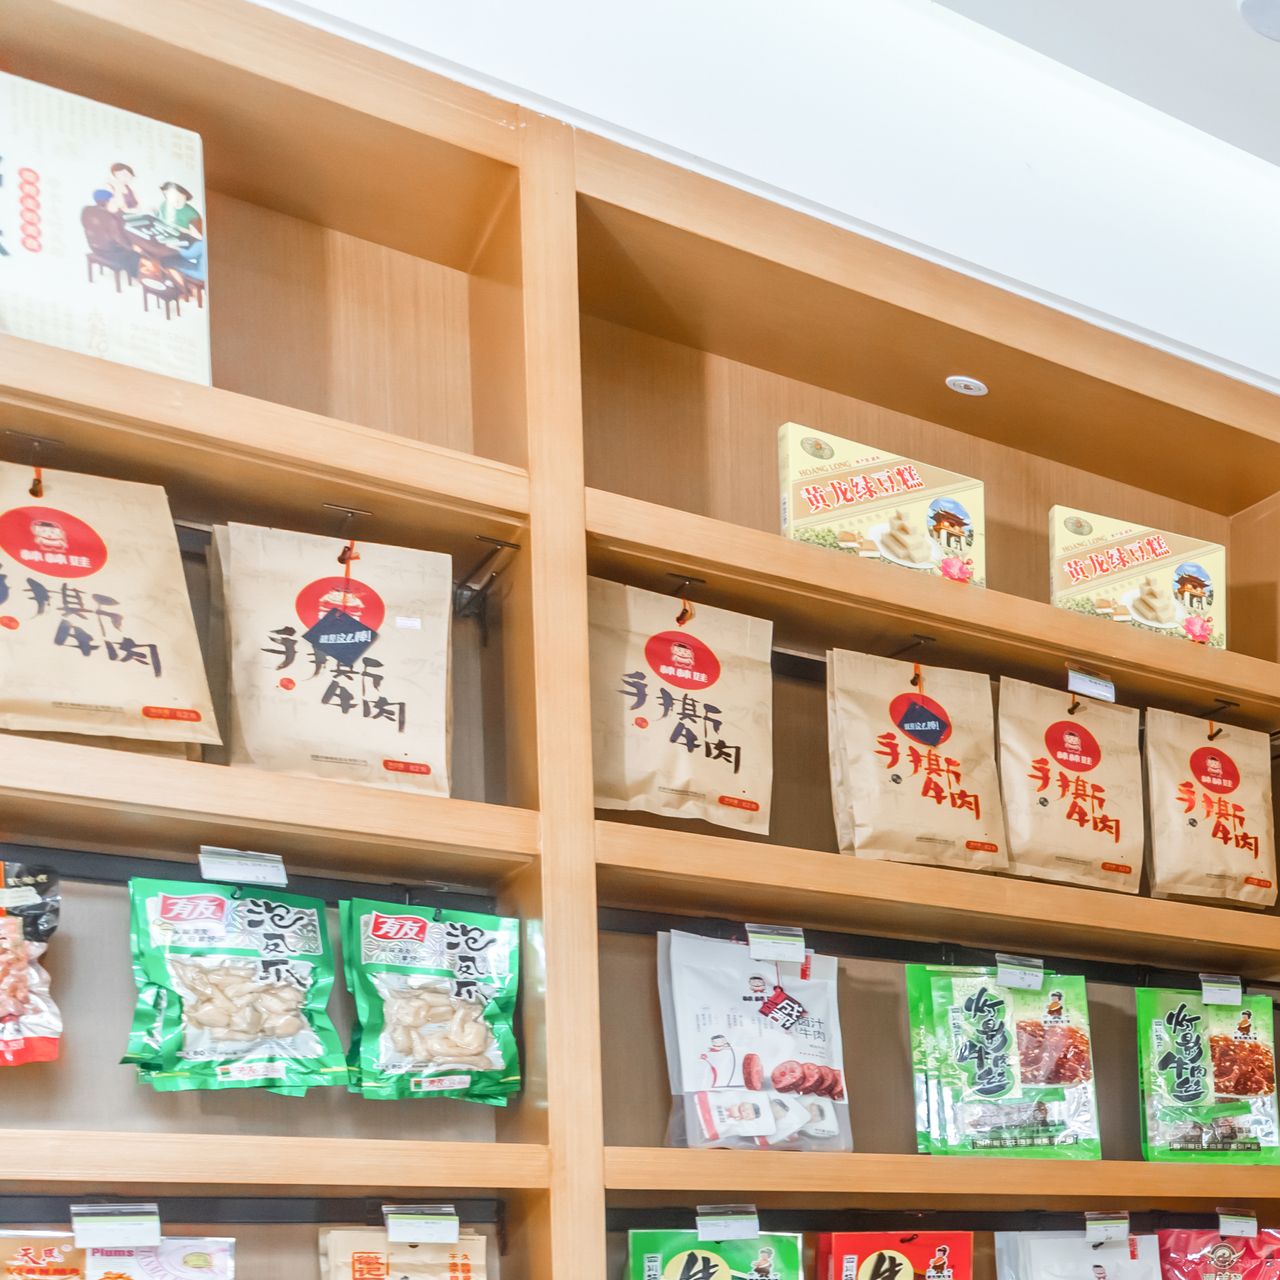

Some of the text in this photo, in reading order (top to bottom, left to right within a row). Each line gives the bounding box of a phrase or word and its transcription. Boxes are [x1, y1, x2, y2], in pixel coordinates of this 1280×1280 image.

[799, 460, 852, 477] HOANG LONG
[800, 466, 925, 512] 黄龙绿豆糕
[1063, 535, 1170, 584] 黄龙绿豆糕
[170, 899, 222, 920] 有友
[378, 917, 425, 940] 有友
[91, 1248, 135, 1258] Plums
